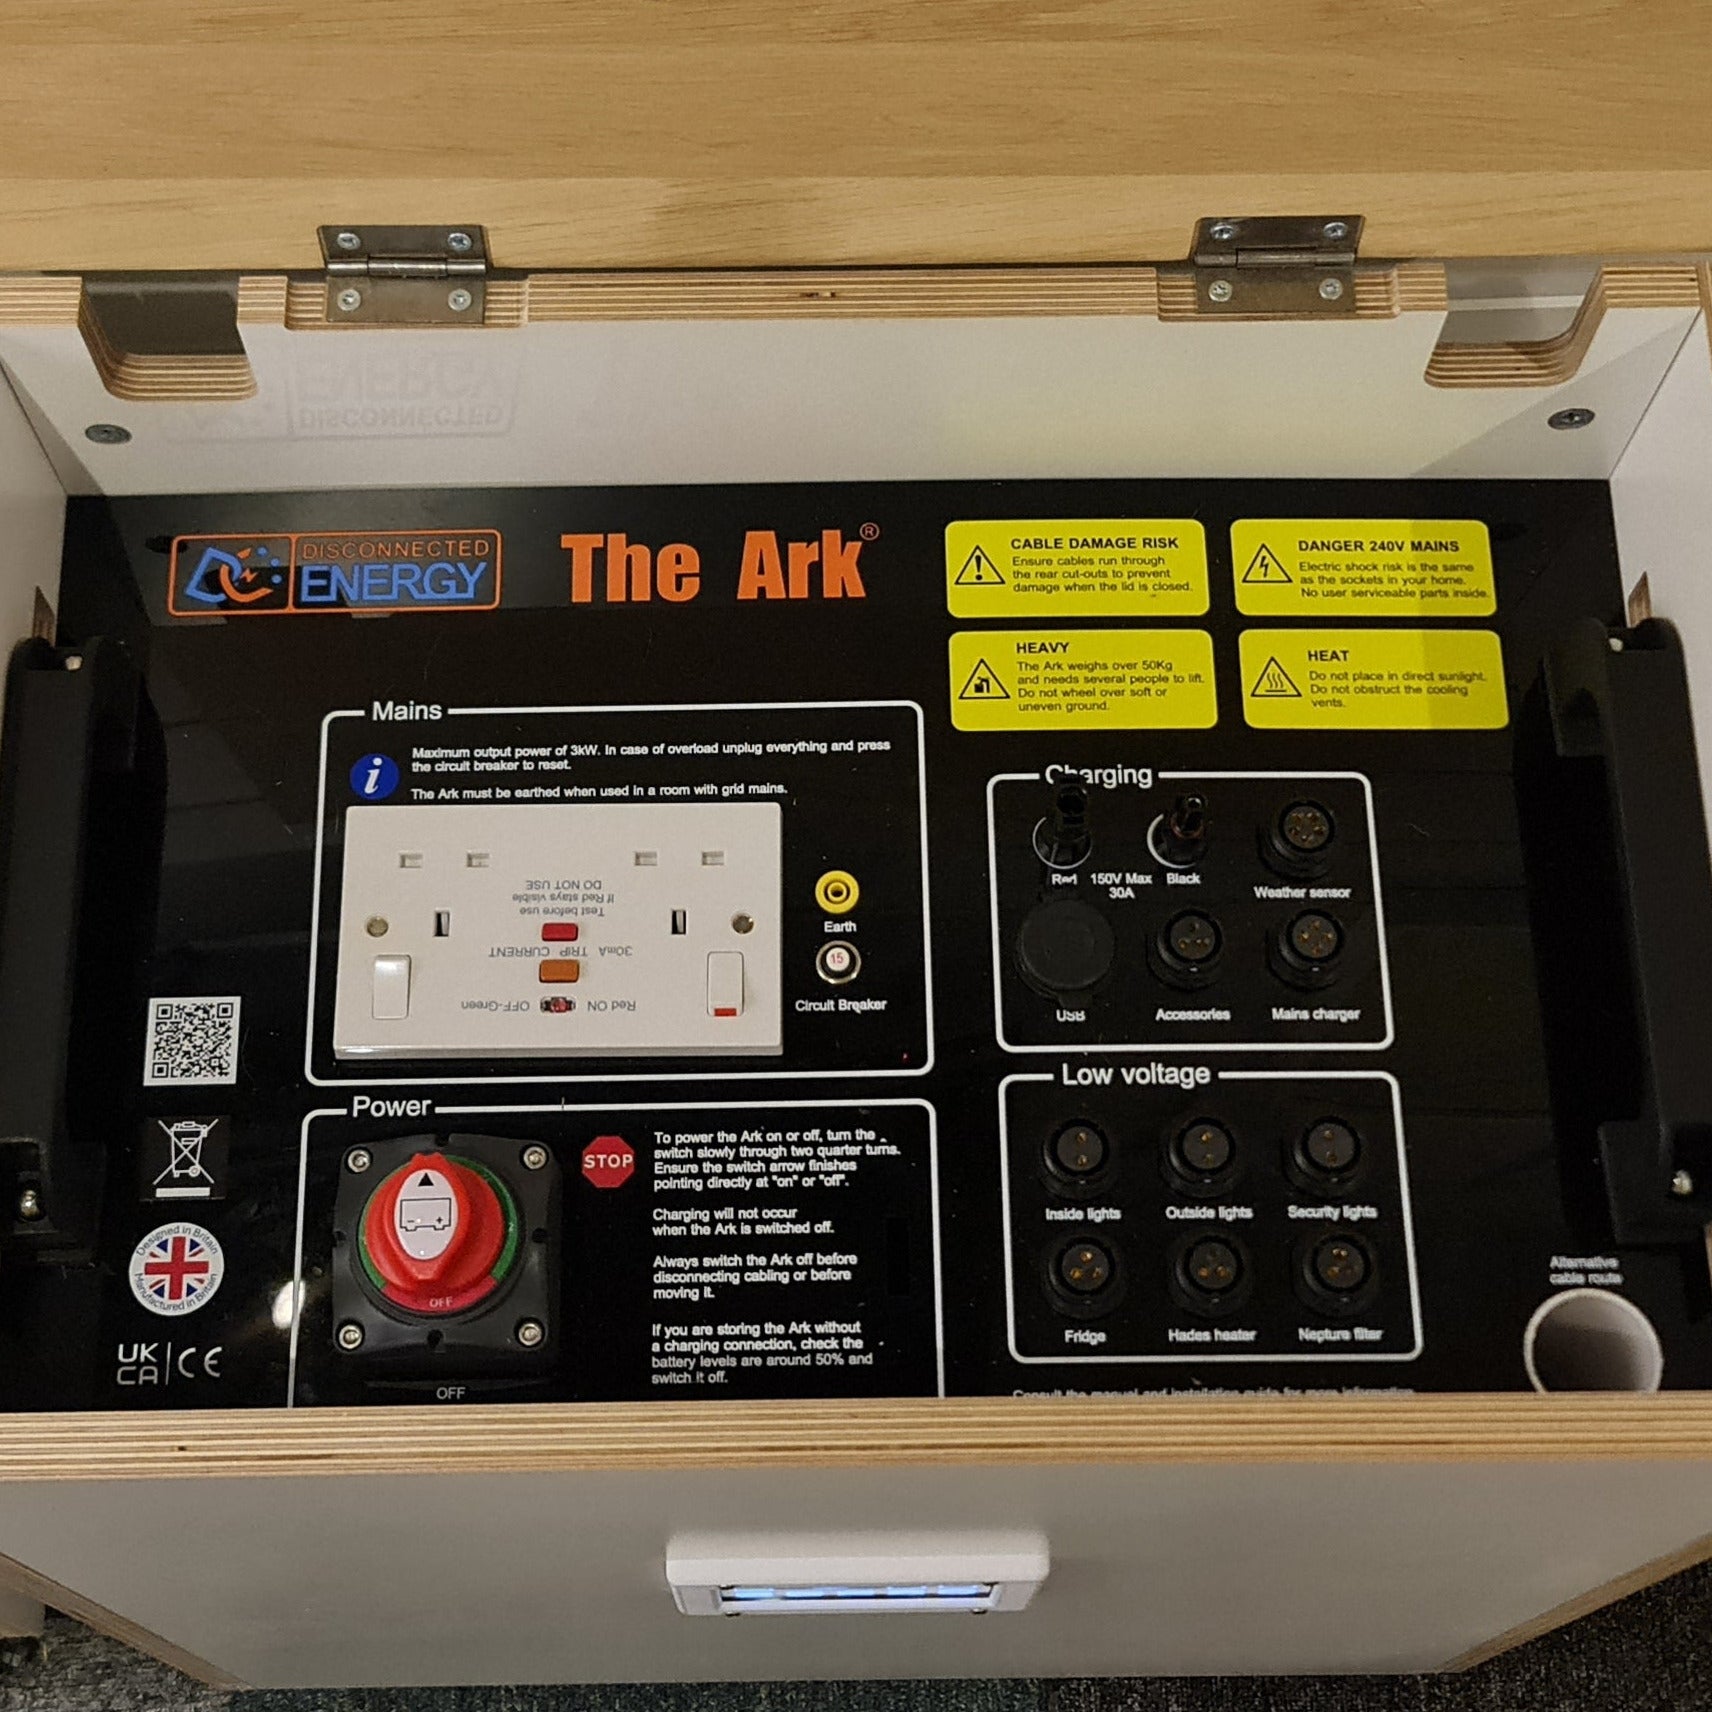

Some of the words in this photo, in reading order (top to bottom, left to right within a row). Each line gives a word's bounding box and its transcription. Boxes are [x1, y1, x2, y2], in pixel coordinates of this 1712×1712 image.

[302, 540, 489, 559] DISCONNECTED
[1011, 538, 1063, 549] CABLE
[1069, 538, 1136, 549] DAMAGE
[1143, 538, 1178, 548] RISK
[1299, 541, 1364, 551] DANGER
[1370, 541, 1404, 551] 240V
[1411, 541, 1459, 552] MAINS
[561, 533, 700, 602] The
[1013, 556, 1053, 567] Ensure
[1057, 556, 1094, 565] cables
[1121, 556, 1165, 567] through
[1013, 570, 1030, 579] the
[1035, 571, 1058, 579] rear
[1062, 569, 1108, 578] cut-outs
[1112, 570, 1123, 578] to
[1127, 570, 1170, 579] prevent
[301, 561, 487, 602] ENERGY
[1013, 583, 1059, 594] damage
[1064, 582, 1095, 591] when
[1100, 582, 1117, 591] the
[1122, 581, 1134, 591] lid
[1139, 582, 1148, 591] is
[1017, 642, 1069, 653] HEAVY
[1308, 650, 1349, 661] HEAT
[373, 701, 442, 720] Mains
[413, 748, 470, 758] Maximum
[474, 747, 511, 759] output
[515, 748, 552, 759] power
[555, 745, 567, 756] of
[571, 745, 600, 755] 3kW.
[605, 745, 616, 755] In
[620, 746, 648, 755] case
[652, 743, 665, 754] of
[668, 743, 718, 754] overload
[723, 742, 762, 755] unplug
[766, 741, 827, 754] everything
[831, 740, 853, 751] and
[858, 741, 890, 753] press
[412, 762, 431, 772] the
[435, 761, 470, 771] circuit
[474, 760, 519, 771] breaker
[523, 760, 534, 770] to
[538, 759, 571, 770] reset.
[411, 789, 434, 799] The
[438, 788, 459, 799] Ark
[463, 788, 492, 798] must
[496, 787, 511, 798] be
[515, 786, 560, 797] earthed
[564, 786, 596, 797] when
[600, 785, 629, 796] used
[633, 785, 644, 795] in
[648, 787, 655, 795] a
[660, 787, 690, 795] room
[694, 784, 718, 794] with
[722, 783, 744, 797] grid
[749, 783, 787, 793] mains.
[1091, 873, 1122, 884] 150V
[1126, 873, 1152, 884] Max
[1167, 873, 1200, 884] Black
[526, 880, 550, 890] USE
[555, 880, 580, 890] NOT
[583, 880, 601, 890] DO
[550, 891, 578, 902] stays
[1109, 887, 1135, 898] 30A
[1254, 886, 1306, 898] Weather
[1309, 889, 1351, 898] sensor
[512, 894, 546, 903] visible
[582, 894, 604, 903] Red
[607, 894, 614, 903] If
[520, 907, 539, 915] use
[543, 907, 578, 917] before
[581, 907, 604, 917] Test
[824, 921, 856, 932] Earth
[489, 946, 550, 957] CURRENT
[560, 947, 587, 957] TRIP
[599, 946, 632, 956] 30mA
[831, 952, 844, 963] 15
[796, 999, 835, 1011] Circuit
[838, 999, 887, 1013] Breaker
[1156, 1008, 1231, 1020] Accessories
[1272, 1008, 1310, 1020] Mains
[1313, 1008, 1360, 1022] charger
[1063, 1063, 1113, 1085] Low
[1121, 1062, 1210, 1089] voltage
[353, 1096, 431, 1117] Power
[654, 1132, 671, 1143] To
[675, 1134, 714, 1146] power
[717, 1131, 737, 1142] the
[741, 1130, 763, 1142] Ark
[766, 1132, 782, 1142] on
[786, 1132, 800, 1141] or
[803, 1129, 823, 1142] off,
[827, 1130, 851, 1141] turn
[855, 1129, 875, 1140] the
[654, 1147, 693, 1159] switch
[697, 1146, 736, 1160] slowly
[739, 1145, 787, 1159] through
[791, 1145, 813, 1156] two
[817, 1144, 862, 1158] quarter
[865, 1144, 901, 1155] turns.
[584, 1154, 633, 1168] STOP
[655, 1162, 698, 1174] Ensure
[702, 1161, 722, 1173] the
[727, 1160, 765, 1173] switch
[770, 1162, 805, 1172] arrow
[809, 1159, 857, 1171] finishes
[654, 1177, 703, 1192] pointing
[707, 1176, 752, 1190] directly
[756, 1176, 768, 1187] at
[772, 1175, 798, 1187] "on"
[802, 1177, 816, 1187] or
[819, 1174, 849, 1186] "off".
[653, 1208, 710, 1223] Charging
[714, 1207, 734, 1219] will
[738, 1208, 759, 1219] not
[762, 1209, 797, 1218] occur
[1046, 1208, 1084, 1220] Inside
[1087, 1207, 1121, 1222] lights
[1166, 1206, 1215, 1219] Outside
[1219, 1206, 1253, 1221] lights
[1288, 1205, 1340, 1221] Security
[1343, 1205, 1377, 1221] lights
[136, 1225, 180, 1256] Designed
[183, 1226, 191, 1234] in
[193, 1228, 218, 1254] Britain
[135, 1273, 185, 1310] Manufactured
[187, 1299, 195, 1307] in
[195, 1273, 218, 1301] Britain
[430, 1297, 452, 1308] OFF
[1065, 1330, 1106, 1345] Fridge
[1169, 1329, 1211, 1341] Hades
[1214, 1329, 1256, 1341] heater
[118, 1343, 158, 1362] UK
[178, 1347, 222, 1378] CE
[117, 1366, 158, 1384] CA
[437, 1387, 465, 1400] OFF
